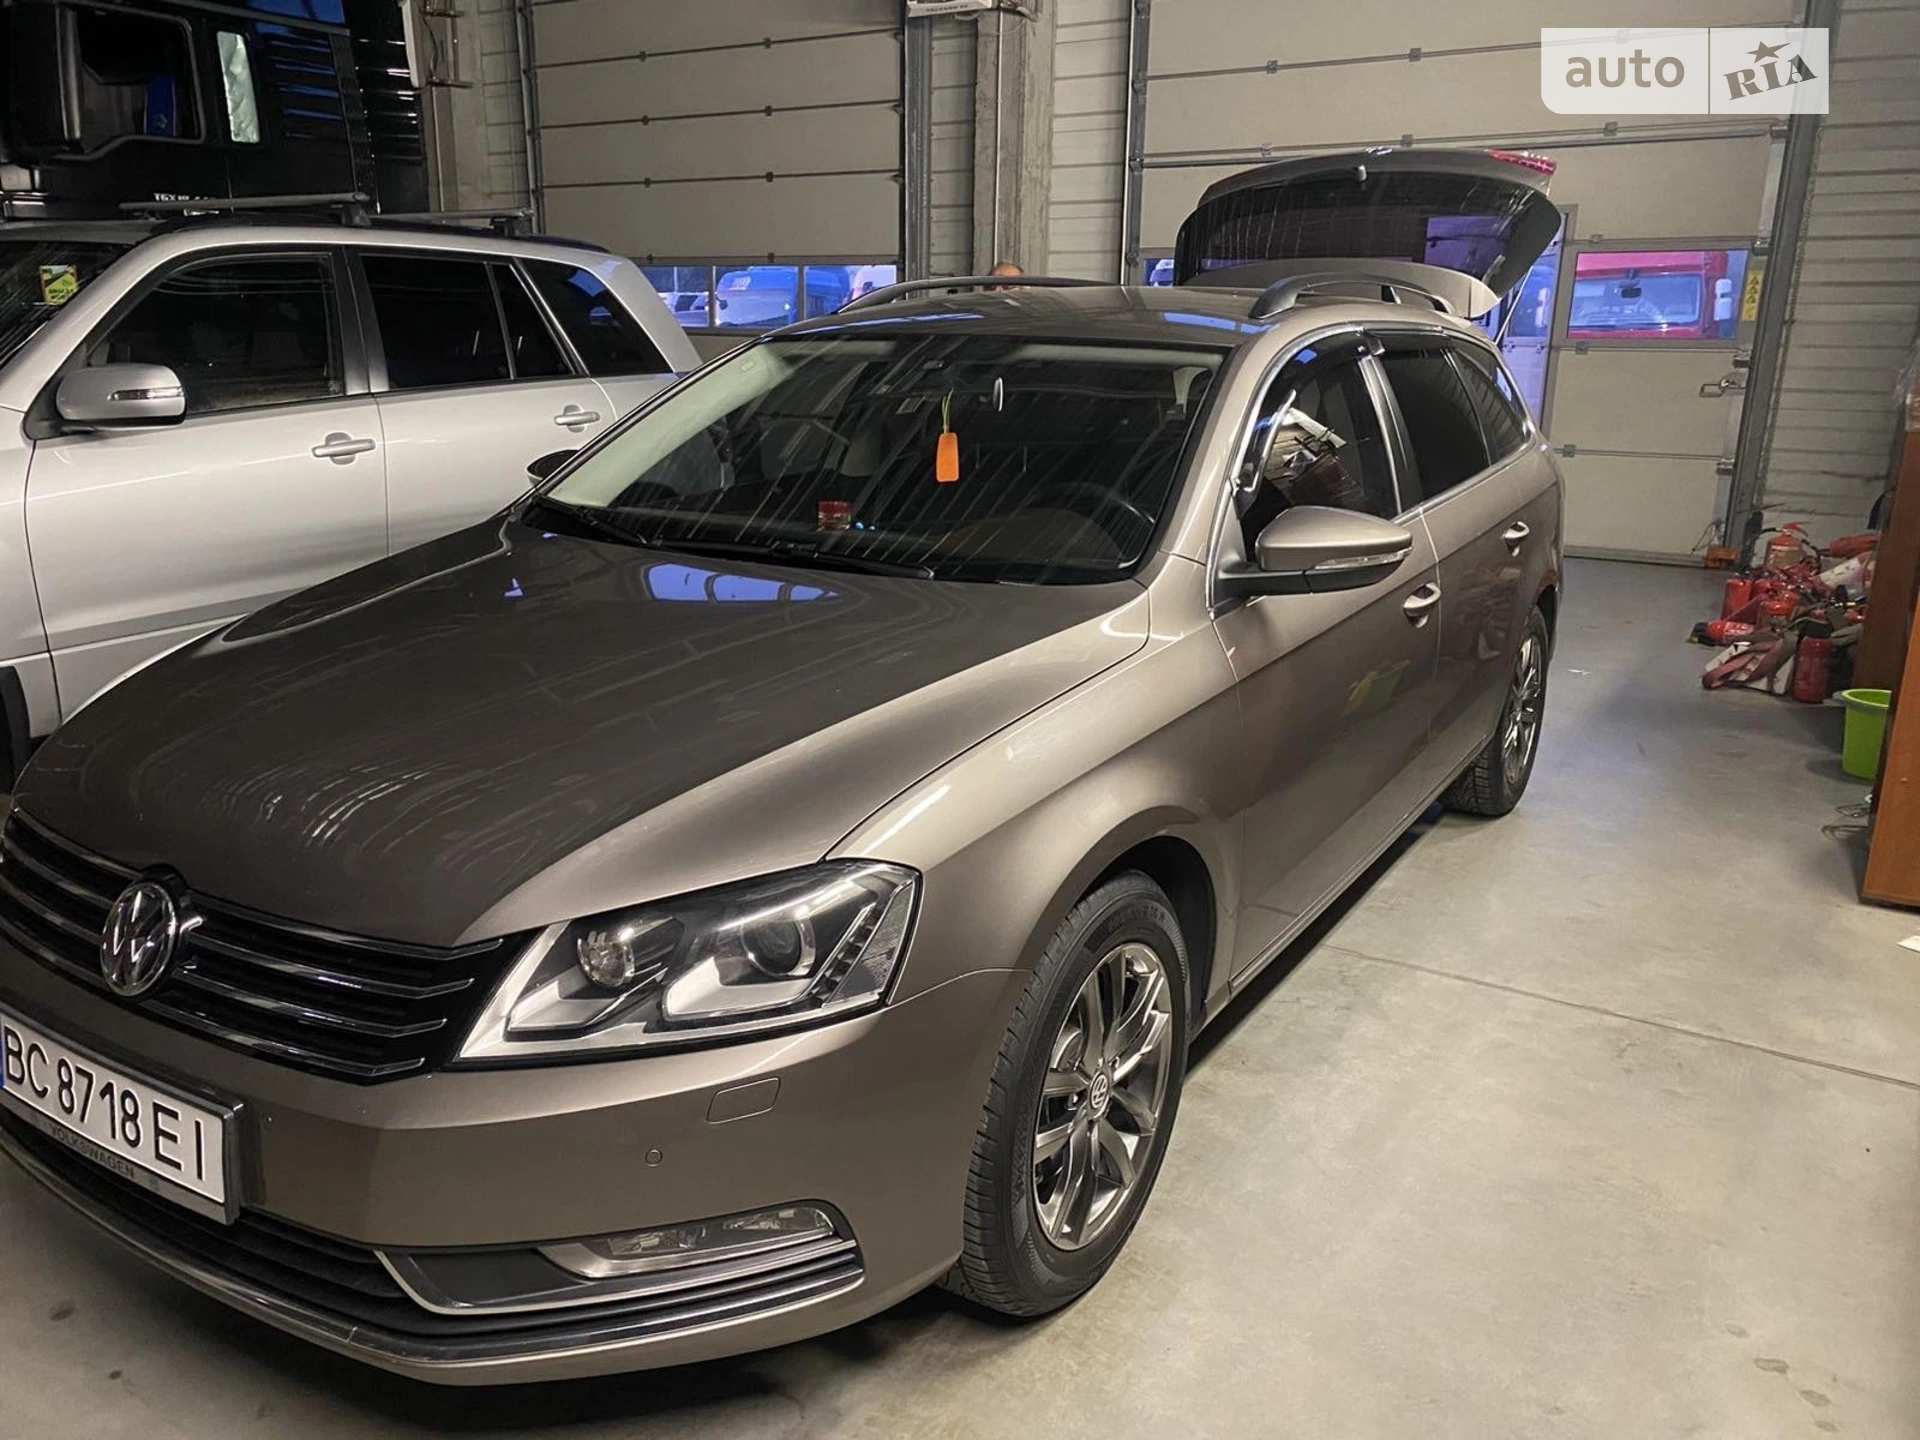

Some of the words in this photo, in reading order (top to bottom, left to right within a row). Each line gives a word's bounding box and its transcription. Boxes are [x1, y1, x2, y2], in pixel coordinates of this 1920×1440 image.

[4, 1025, 49, 1098] BC
[57, 1058, 141, 1148] 8718
[152, 1101, 204, 1181] EI
[50, 1123, 136, 1179] VOLKSWAGEN
